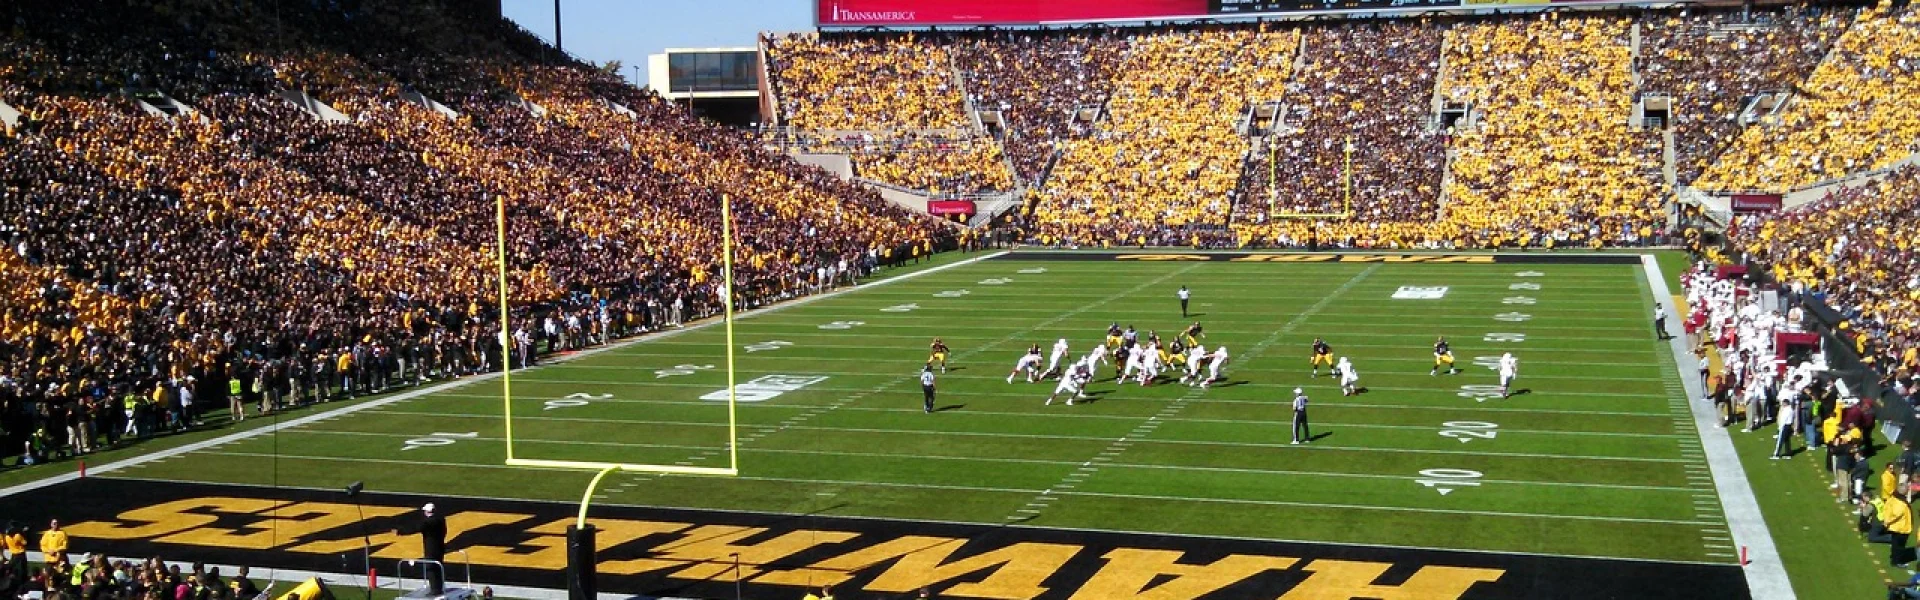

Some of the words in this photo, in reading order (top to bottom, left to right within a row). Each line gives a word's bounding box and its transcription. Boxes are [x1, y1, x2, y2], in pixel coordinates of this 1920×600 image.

[839, 9, 915, 21] TRANSAMERICA
[1229, 253, 1496, 263] IOWA
[1457, 384, 1507, 399] 30
[543, 392, 615, 407] 20
[1438, 420, 1499, 439] 20
[404, 431, 479, 447] 10
[1414, 468, 1485, 487] 10
